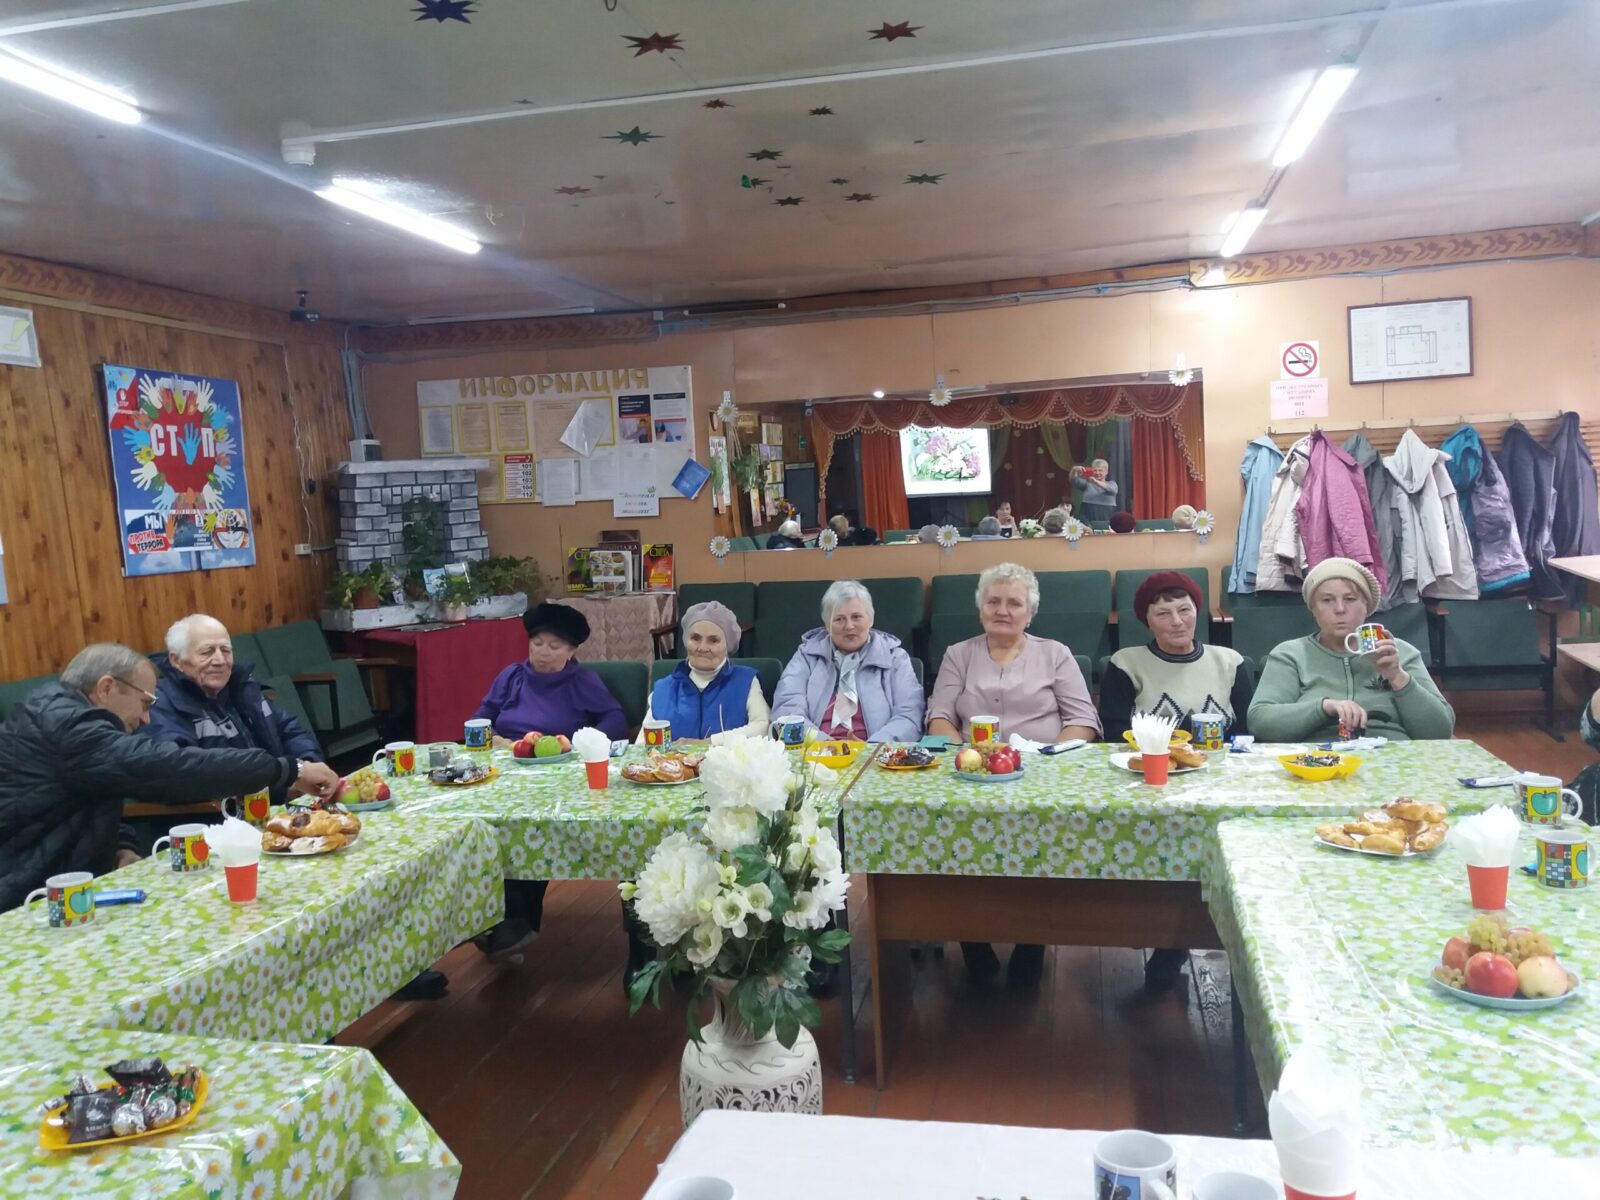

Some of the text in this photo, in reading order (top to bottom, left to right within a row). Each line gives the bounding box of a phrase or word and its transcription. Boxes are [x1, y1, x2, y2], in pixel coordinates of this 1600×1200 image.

[460, 369, 649, 398] ИНФОРМАЦИЯ
[151, 423, 215, 460] СТП
[145, 515, 163, 530] МЫ
[137, 539, 163, 551] ТЕРРОРА
